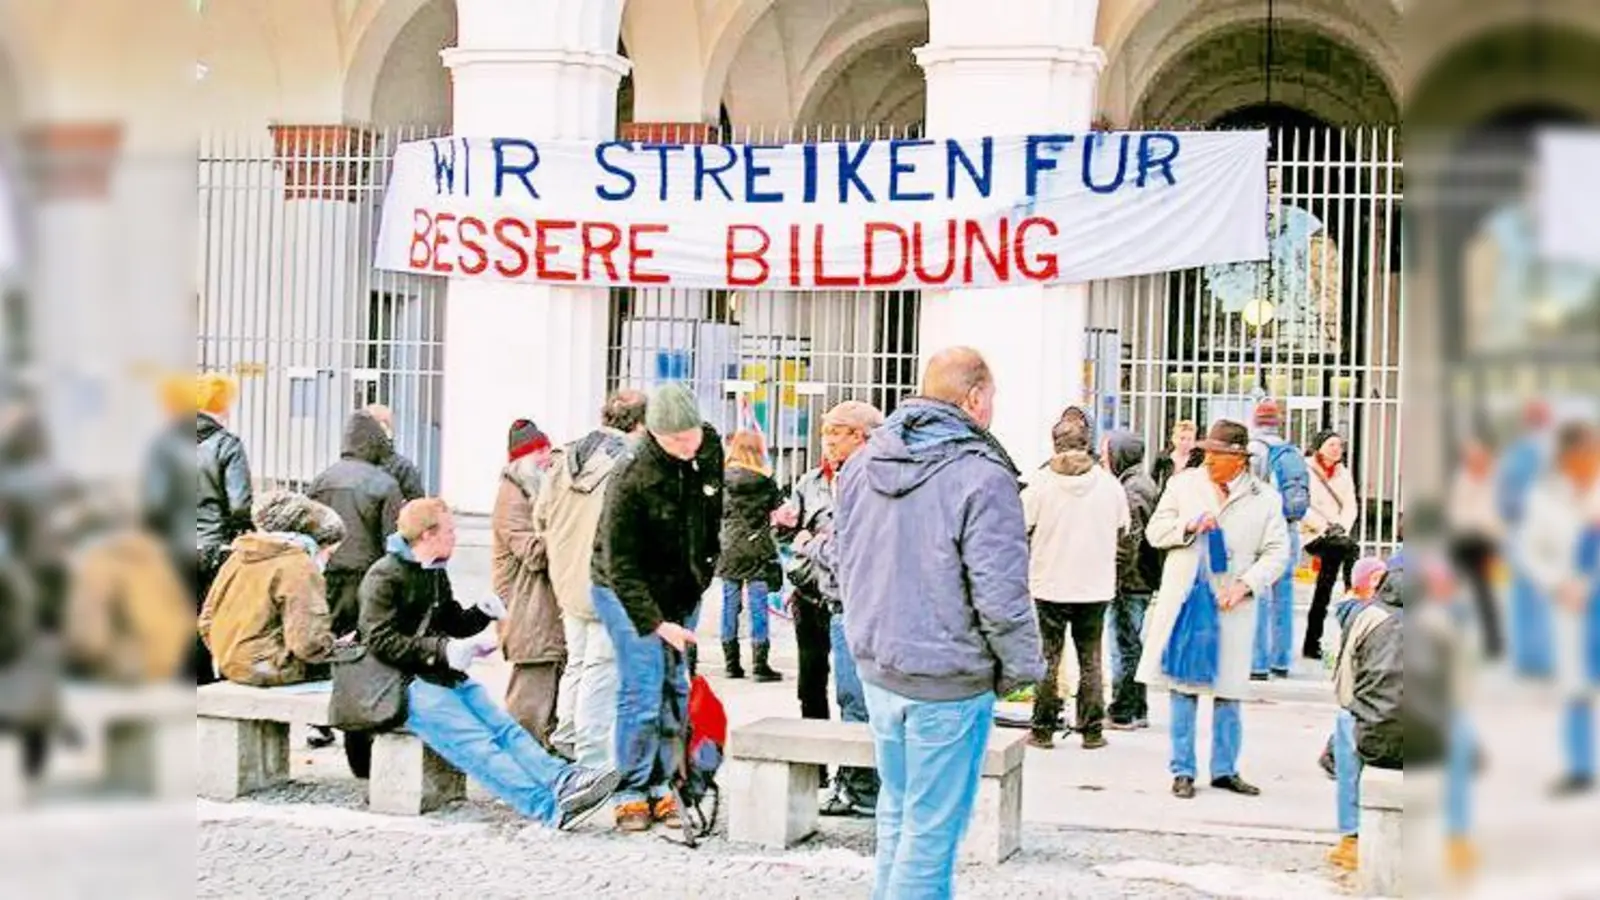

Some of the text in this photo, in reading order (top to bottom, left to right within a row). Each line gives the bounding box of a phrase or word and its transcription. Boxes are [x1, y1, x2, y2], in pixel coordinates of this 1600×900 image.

[433, 137, 540, 199] WIR
[595, 136, 994, 203] STREIKEN
[409, 209, 1060, 287] BESSERE BILDUNG
